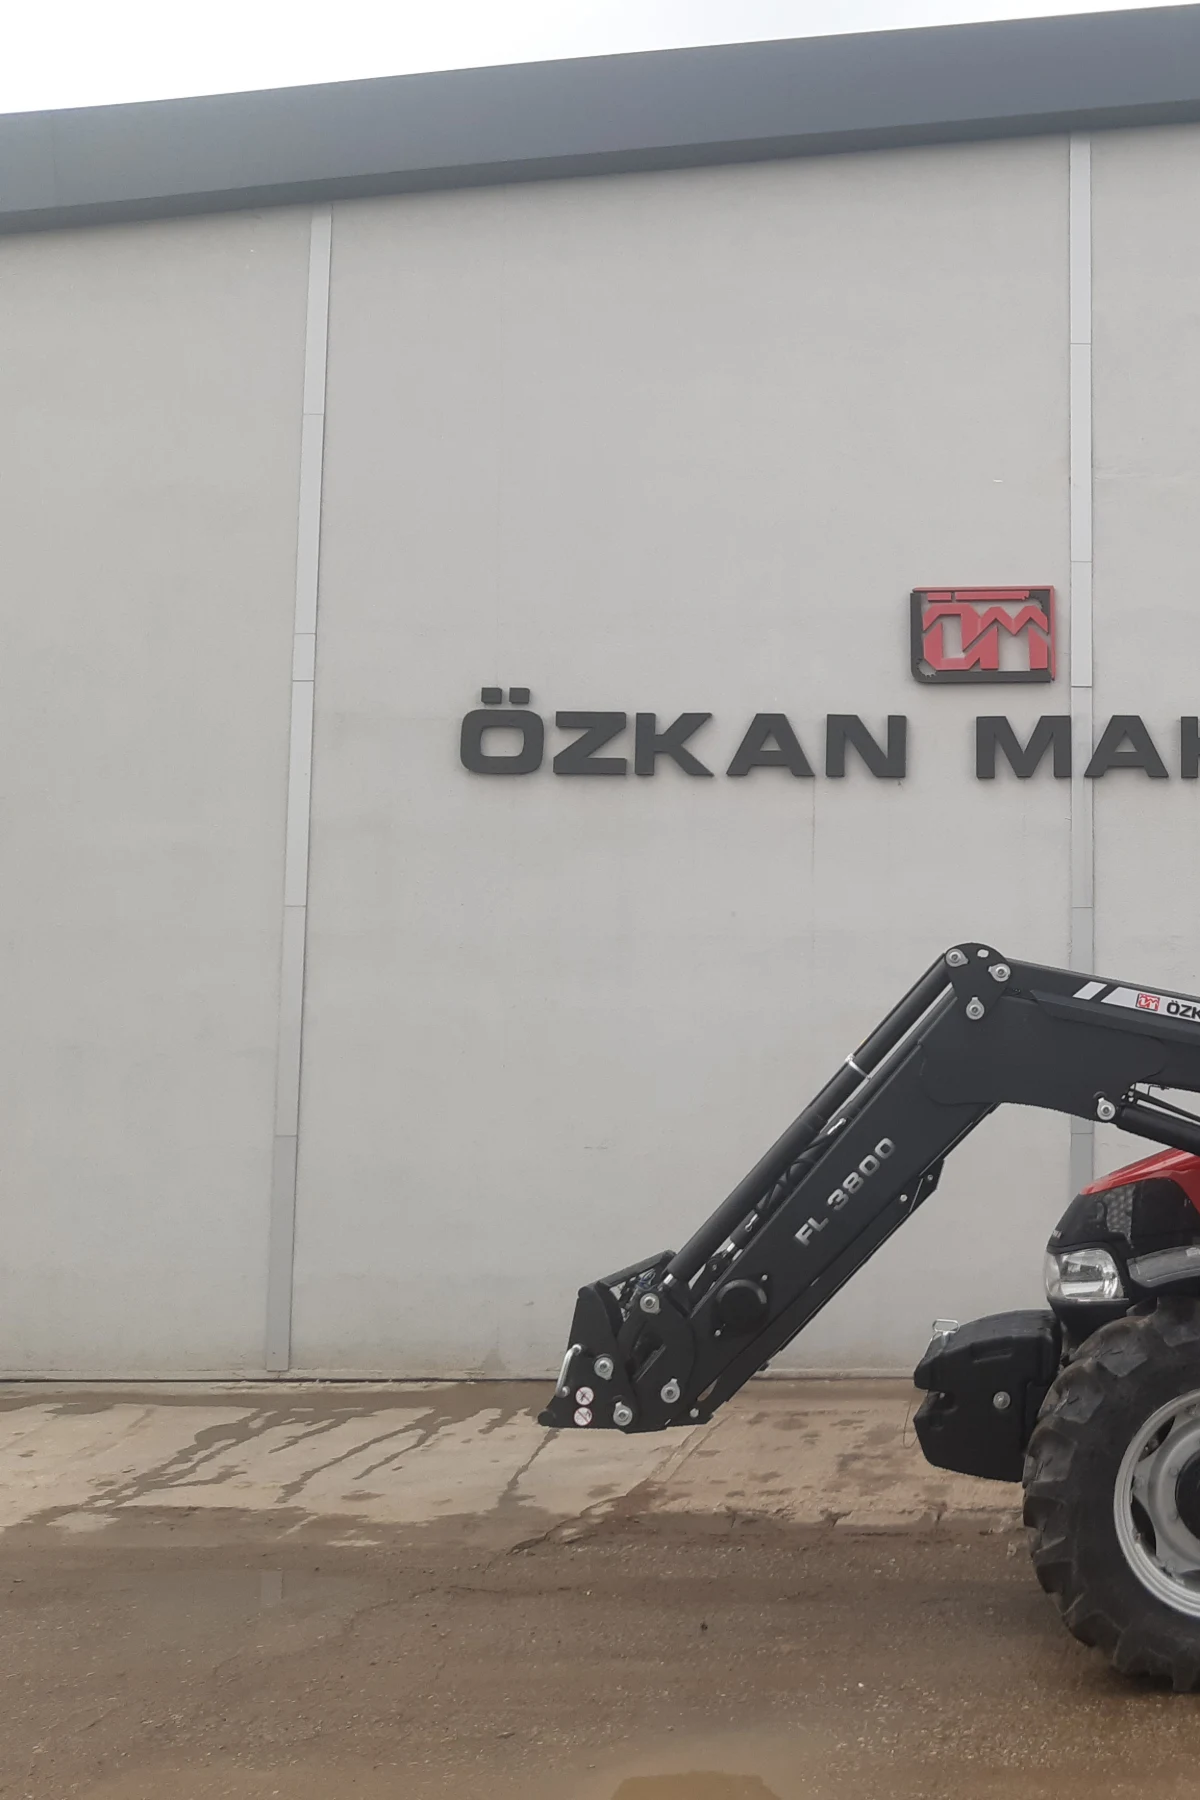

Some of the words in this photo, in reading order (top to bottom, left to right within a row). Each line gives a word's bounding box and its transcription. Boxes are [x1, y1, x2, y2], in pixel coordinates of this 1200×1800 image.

[460, 687, 907, 778] ÖZKAN
[794, 1217, 829, 1246] FL
[827, 1137, 895, 1211] 3800
